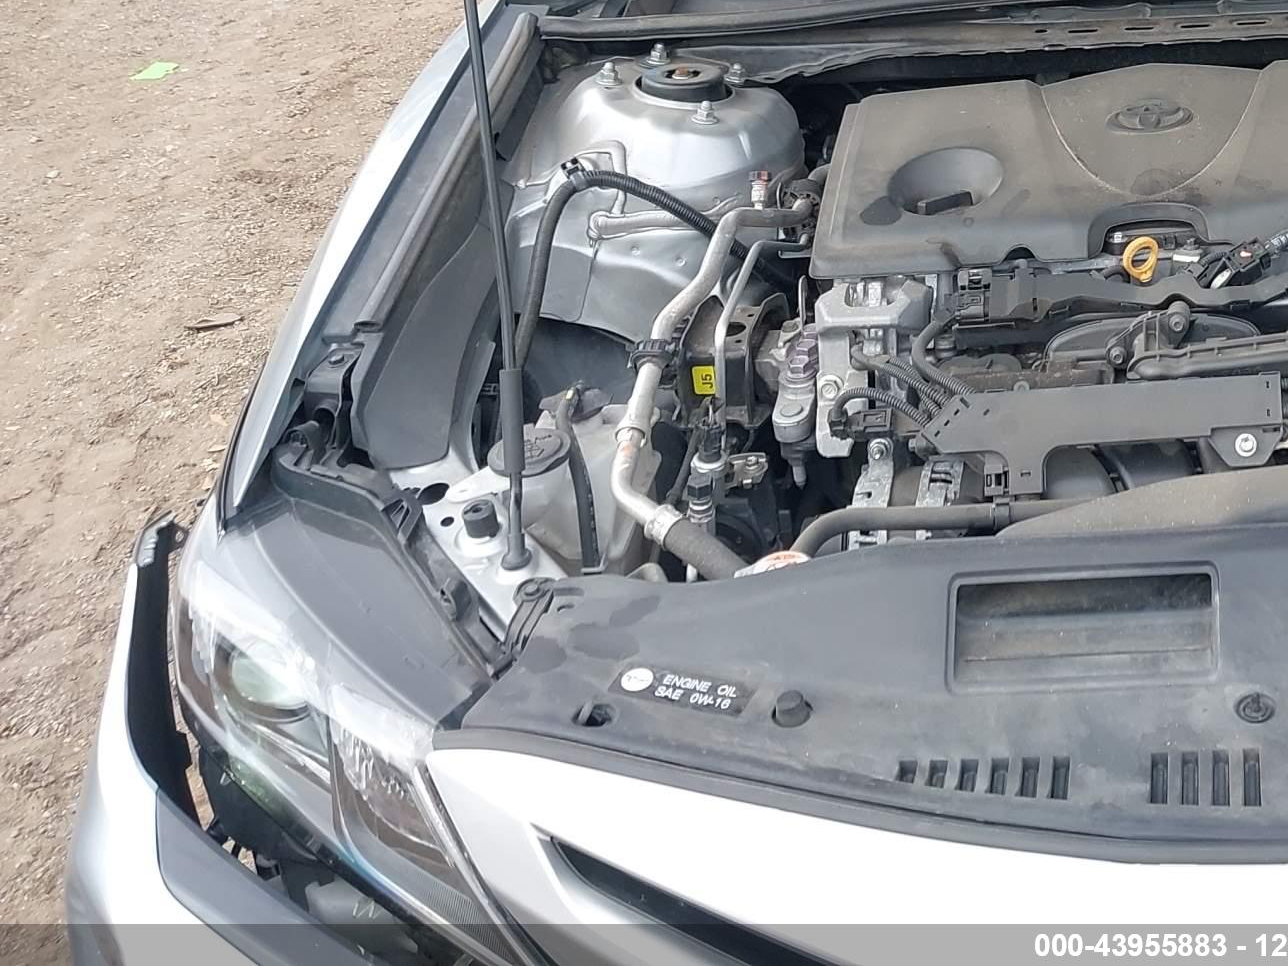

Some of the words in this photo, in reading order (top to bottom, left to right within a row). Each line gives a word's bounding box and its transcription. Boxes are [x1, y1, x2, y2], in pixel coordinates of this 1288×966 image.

[700, 373, 714, 390] J5
[654, 685, 685, 701] SAE
[689, 692, 732, 710] 0W-16
[662, 673, 713, 693] ENGINE
[716, 684, 737, 698] OIL
